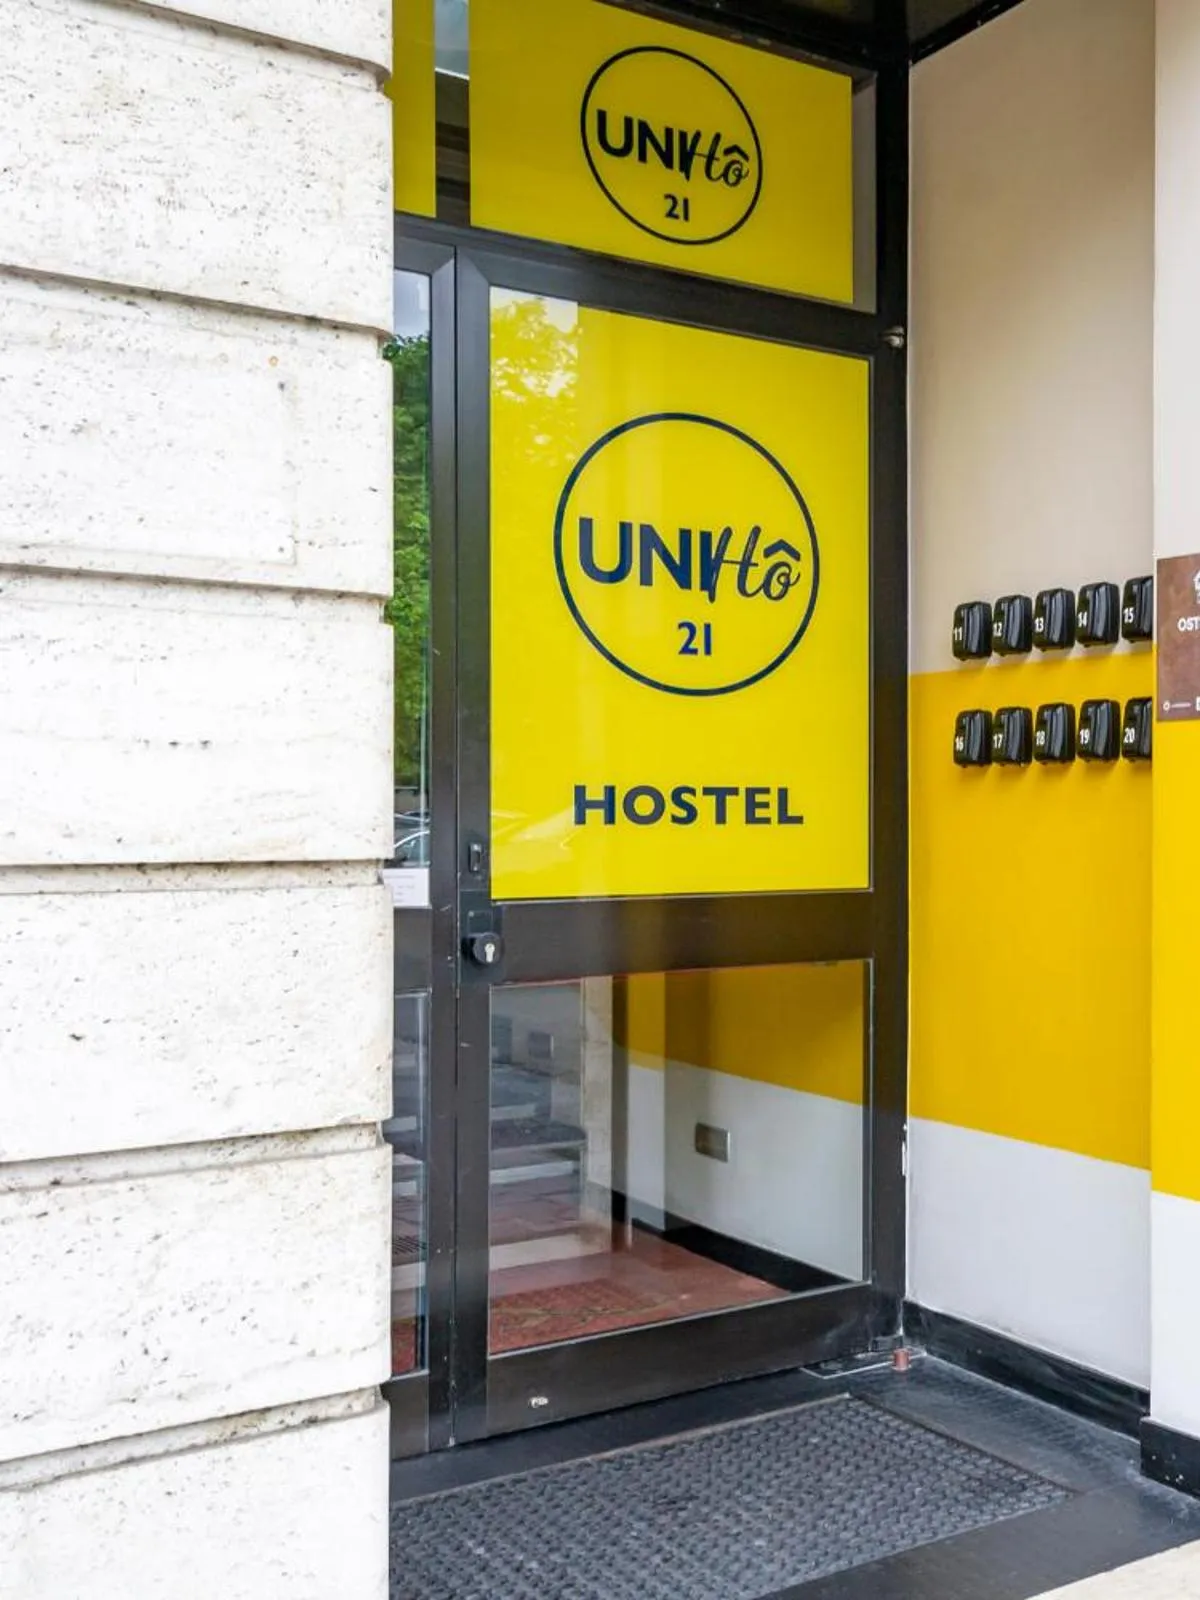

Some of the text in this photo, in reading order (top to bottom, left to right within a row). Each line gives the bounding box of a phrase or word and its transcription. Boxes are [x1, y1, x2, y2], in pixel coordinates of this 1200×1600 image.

[664, 193, 690, 222] 21
[1078, 612, 1088, 628] 14
[1124, 607, 1134, 623] 15
[993, 622, 1002, 637] 12
[1035, 617, 1044, 633] 13
[677, 622, 712, 656] 21
[954, 627, 963, 641] 11
[955, 736, 964, 751] 16
[993, 733, 1002, 749] 17
[1036, 730, 1046, 746] 18
[1079, 728, 1090, 744] 19
[1124, 727, 1136, 744] 20
[574, 785, 804, 825] HOSTEL
